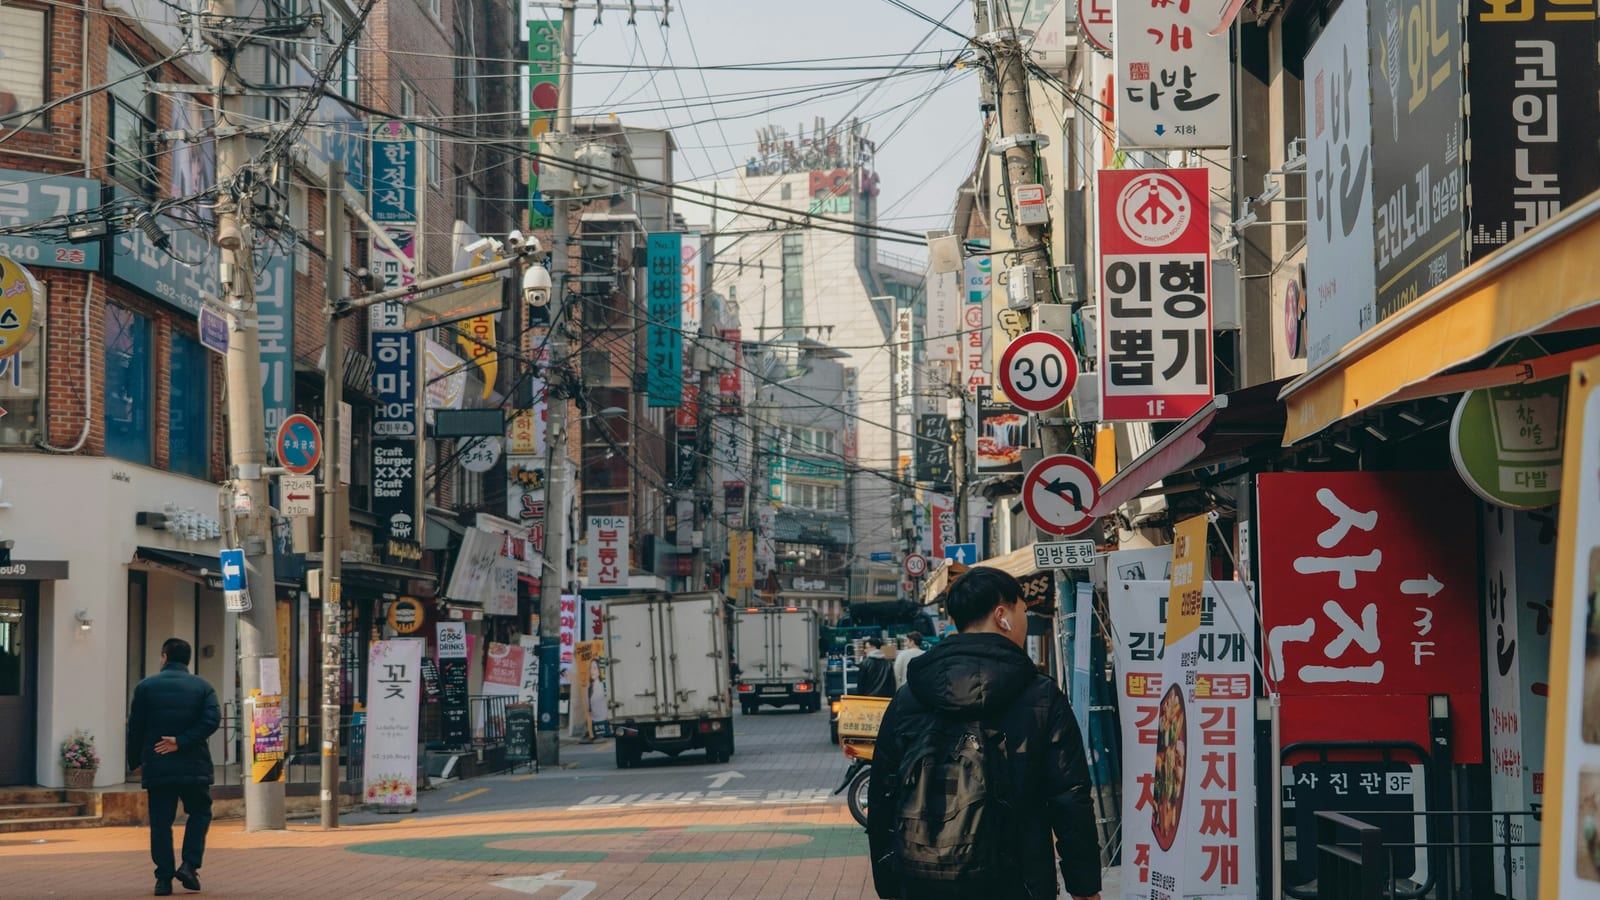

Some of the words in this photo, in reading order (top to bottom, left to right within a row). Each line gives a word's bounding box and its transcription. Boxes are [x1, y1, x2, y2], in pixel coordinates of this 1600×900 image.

[1147, 0, 1192, 52] 개
[1126, 65, 1220, 111] 다발
[1174, 125, 1196, 135] 지하
[381, 143, 410, 210] 한정식
[1378, 163, 1430, 271] 코인노래
[1432, 167, 1459, 223] 연습장
[56, 249, 85, 264] 2층
[385, 262, 398, 327] ENER
[1105, 261, 1206, 319] 인형
[376, 336, 411, 400] 하마
[1109, 329, 1208, 386] 뽑기
[1014, 353, 1064, 393] 30
[374, 403, 414, 418] HOF
[1146, 400, 1165, 416] 1F
[284, 440, 316, 450] 주차금지
[374, 447, 403, 457] Craft
[374, 457, 413, 467] Burger
[284, 480, 313, 490] 구간시작
[374, 478, 403, 488] Craft
[1514, 471, 1548, 488] 다발
[374, 488, 402, 497] Beer
[591, 518, 624, 528] 에이스
[598, 530, 620, 584] 부동산
[910, 560, 922, 570] 30
[1037, 543, 1093, 566] 일방통행
[440, 643, 464, 651] DRINKS
[1128, 632, 1245, 662] 김개
[1411, 607, 1435, 665] 3F
[378, 664, 412, 700] 꽃
[1297, 772, 1381, 795] 사진관
[1390, 776, 1411, 791] 3F
[1199, 706, 1239, 885] 김치찌개
